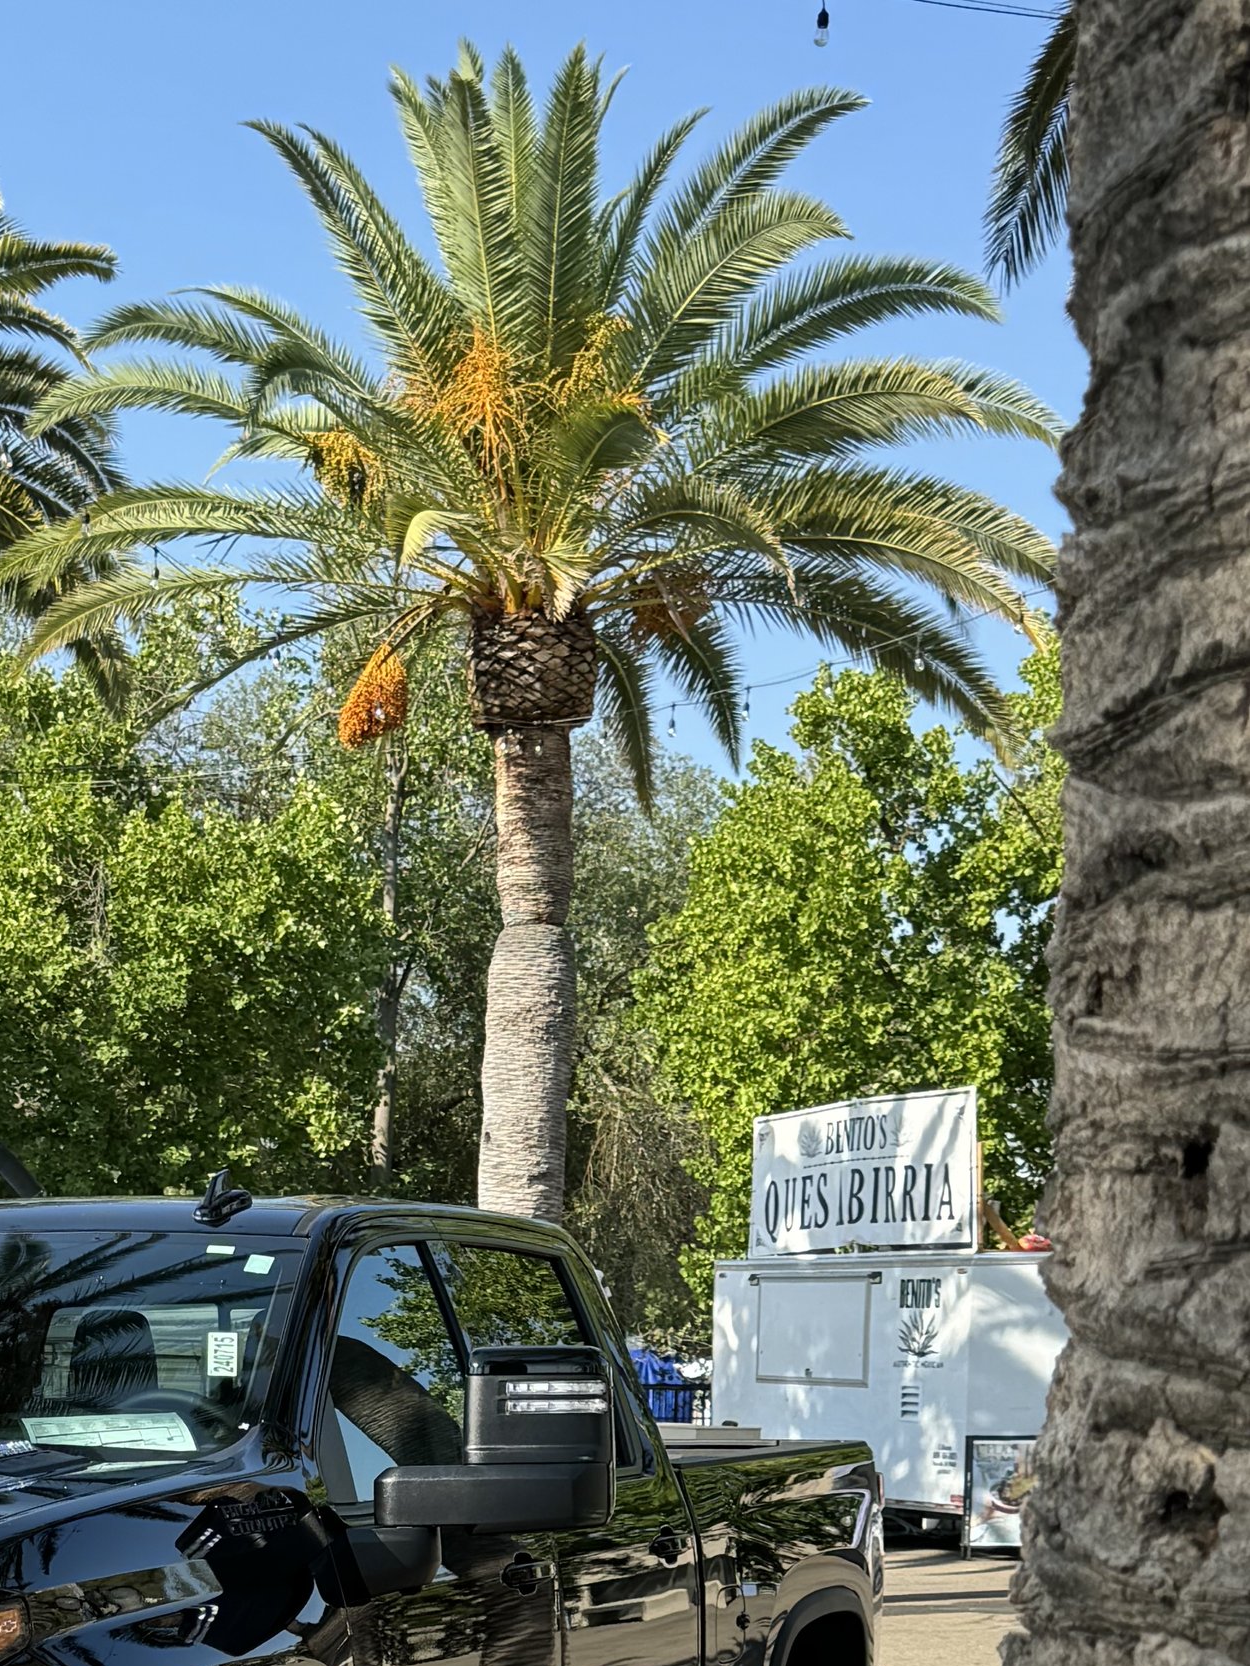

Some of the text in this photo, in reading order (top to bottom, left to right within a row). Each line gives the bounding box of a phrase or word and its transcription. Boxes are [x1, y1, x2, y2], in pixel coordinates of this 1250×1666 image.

[824, 1114, 888, 1155] BENITO'S
[764, 1163, 956, 1243] QUESIBIRRIA
[899, 1277, 942, 1309] BENITO'S
[213, 1336, 235, 1373] 240715
